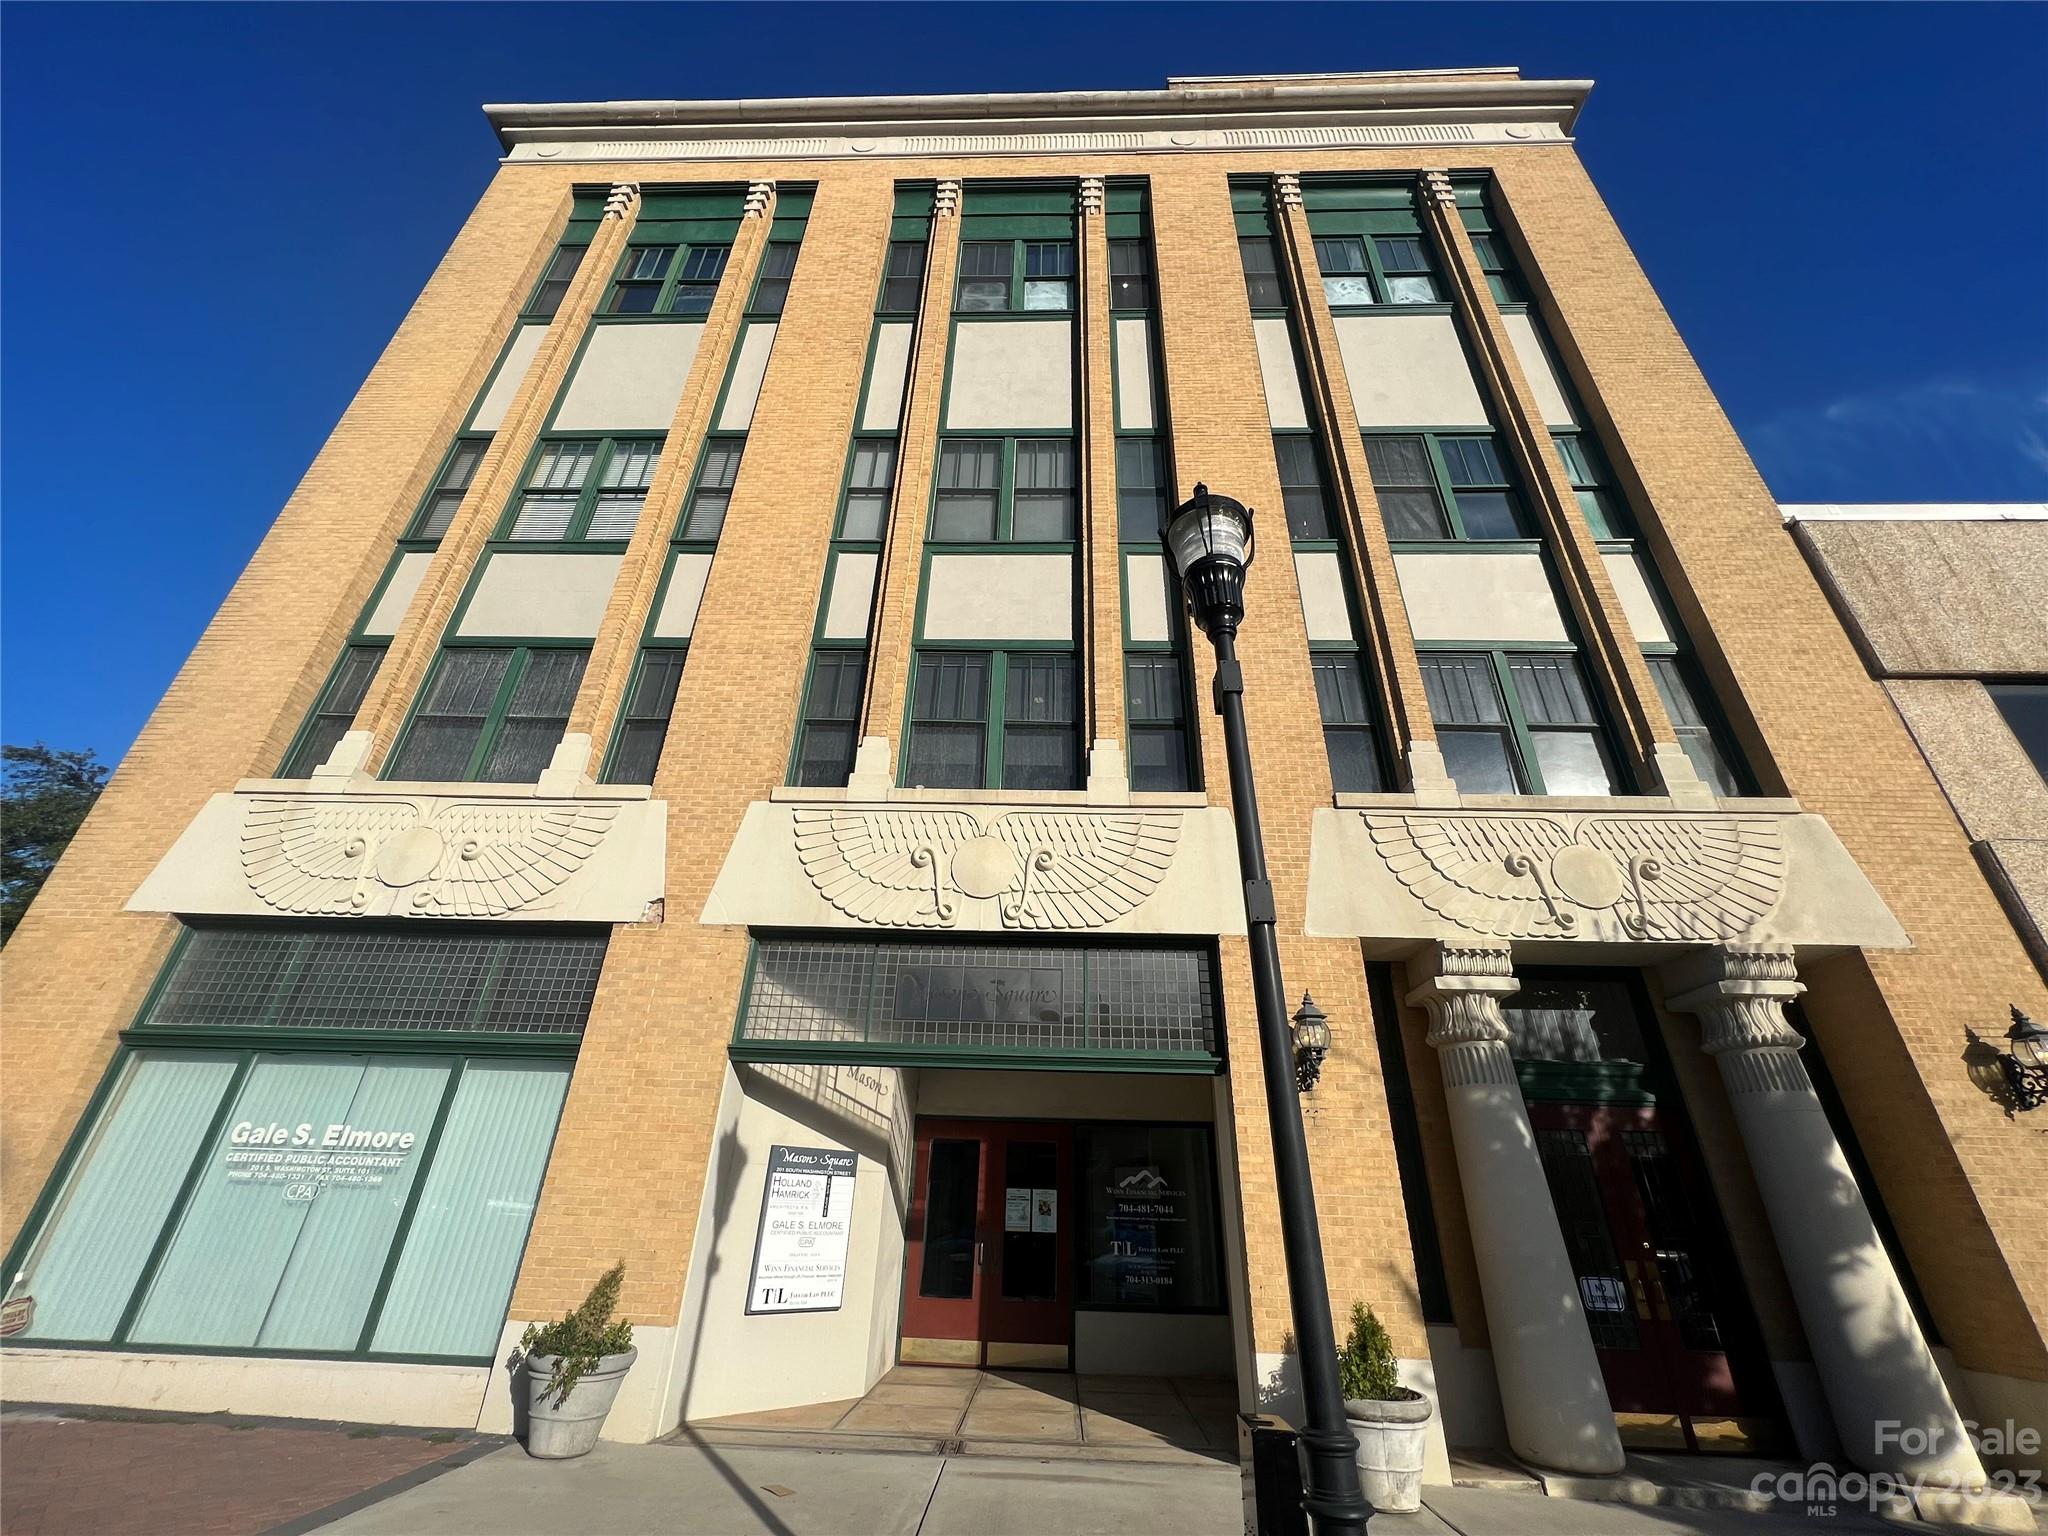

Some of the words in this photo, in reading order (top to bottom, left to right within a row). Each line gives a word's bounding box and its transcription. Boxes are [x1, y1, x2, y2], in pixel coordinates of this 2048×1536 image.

[231, 1121, 288, 1146] Gale
[292, 1123, 315, 1146] S.
[322, 1124, 415, 1149] Elmore
[226, 1152, 283, 1164] CERTIFIED
[285, 1154, 325, 1165] PUBLIC
[328, 1156, 404, 1168] ACCOUNTANT
[780, 1147, 817, 1164] Mason
[820, 1154, 854, 1170] Square
[773, 1176, 812, 1188] HOLLAND
[286, 1185, 312, 1199] CPA
[771, 1187, 810, 1199] HAMRICK
[1118, 1203, 1174, 1214] 704-481-7044
[772, 1220, 796, 1229] GALE
[808, 1221, 844, 1230] ELMORE
[1594, 1283, 1607, 1293] NO
